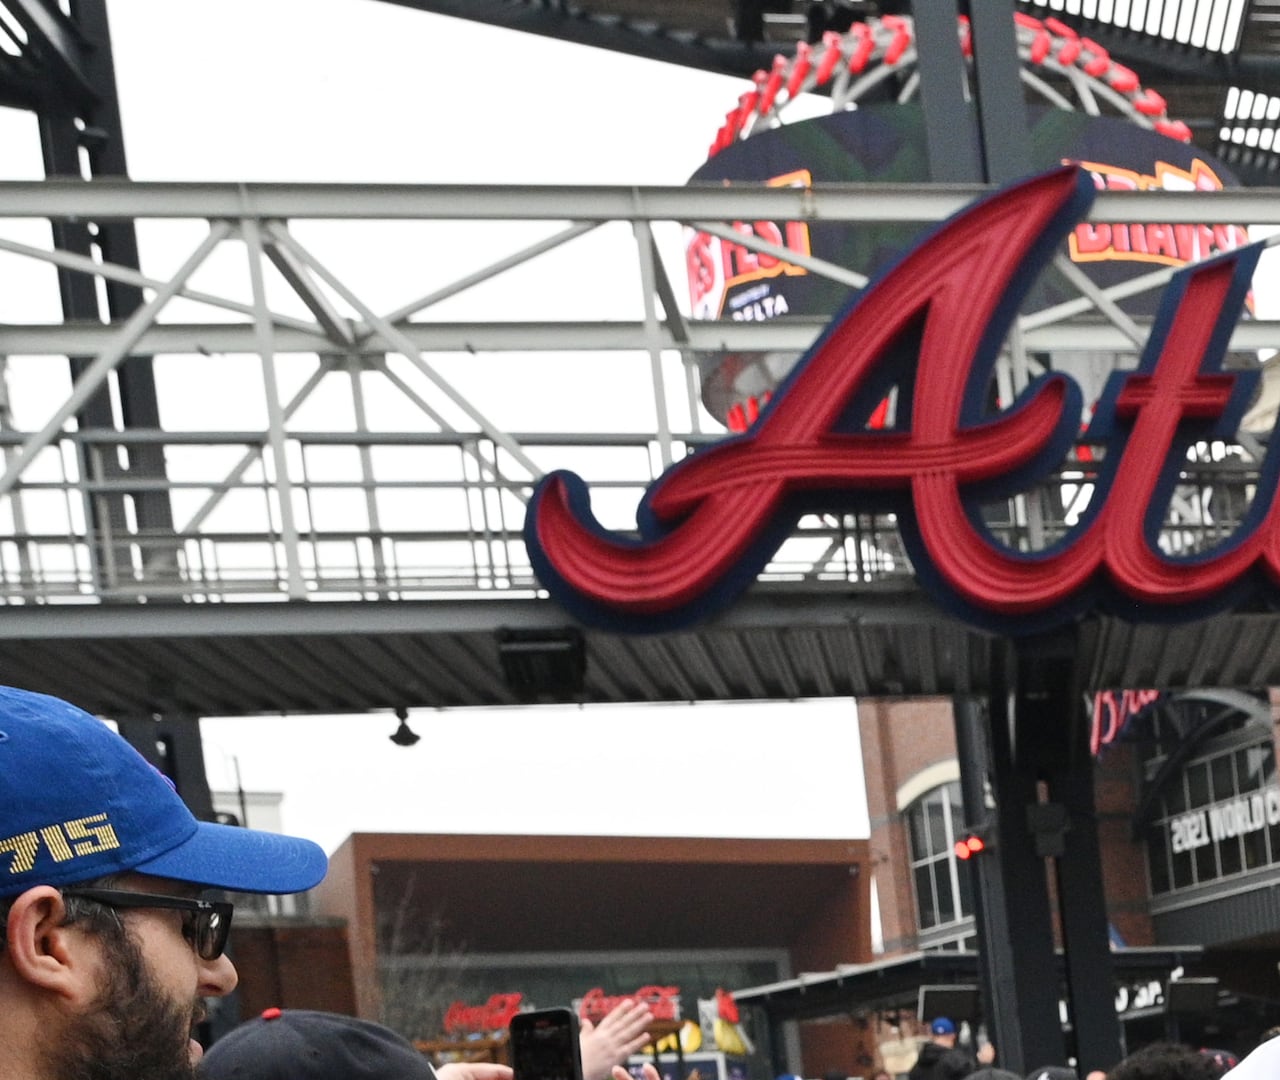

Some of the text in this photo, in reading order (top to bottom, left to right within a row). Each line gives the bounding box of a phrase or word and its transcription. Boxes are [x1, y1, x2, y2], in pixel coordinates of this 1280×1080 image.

[0, 812, 121, 874] 715
[1171, 809, 1210, 854] 2021
[1209, 793, 1266, 843] WORLD
